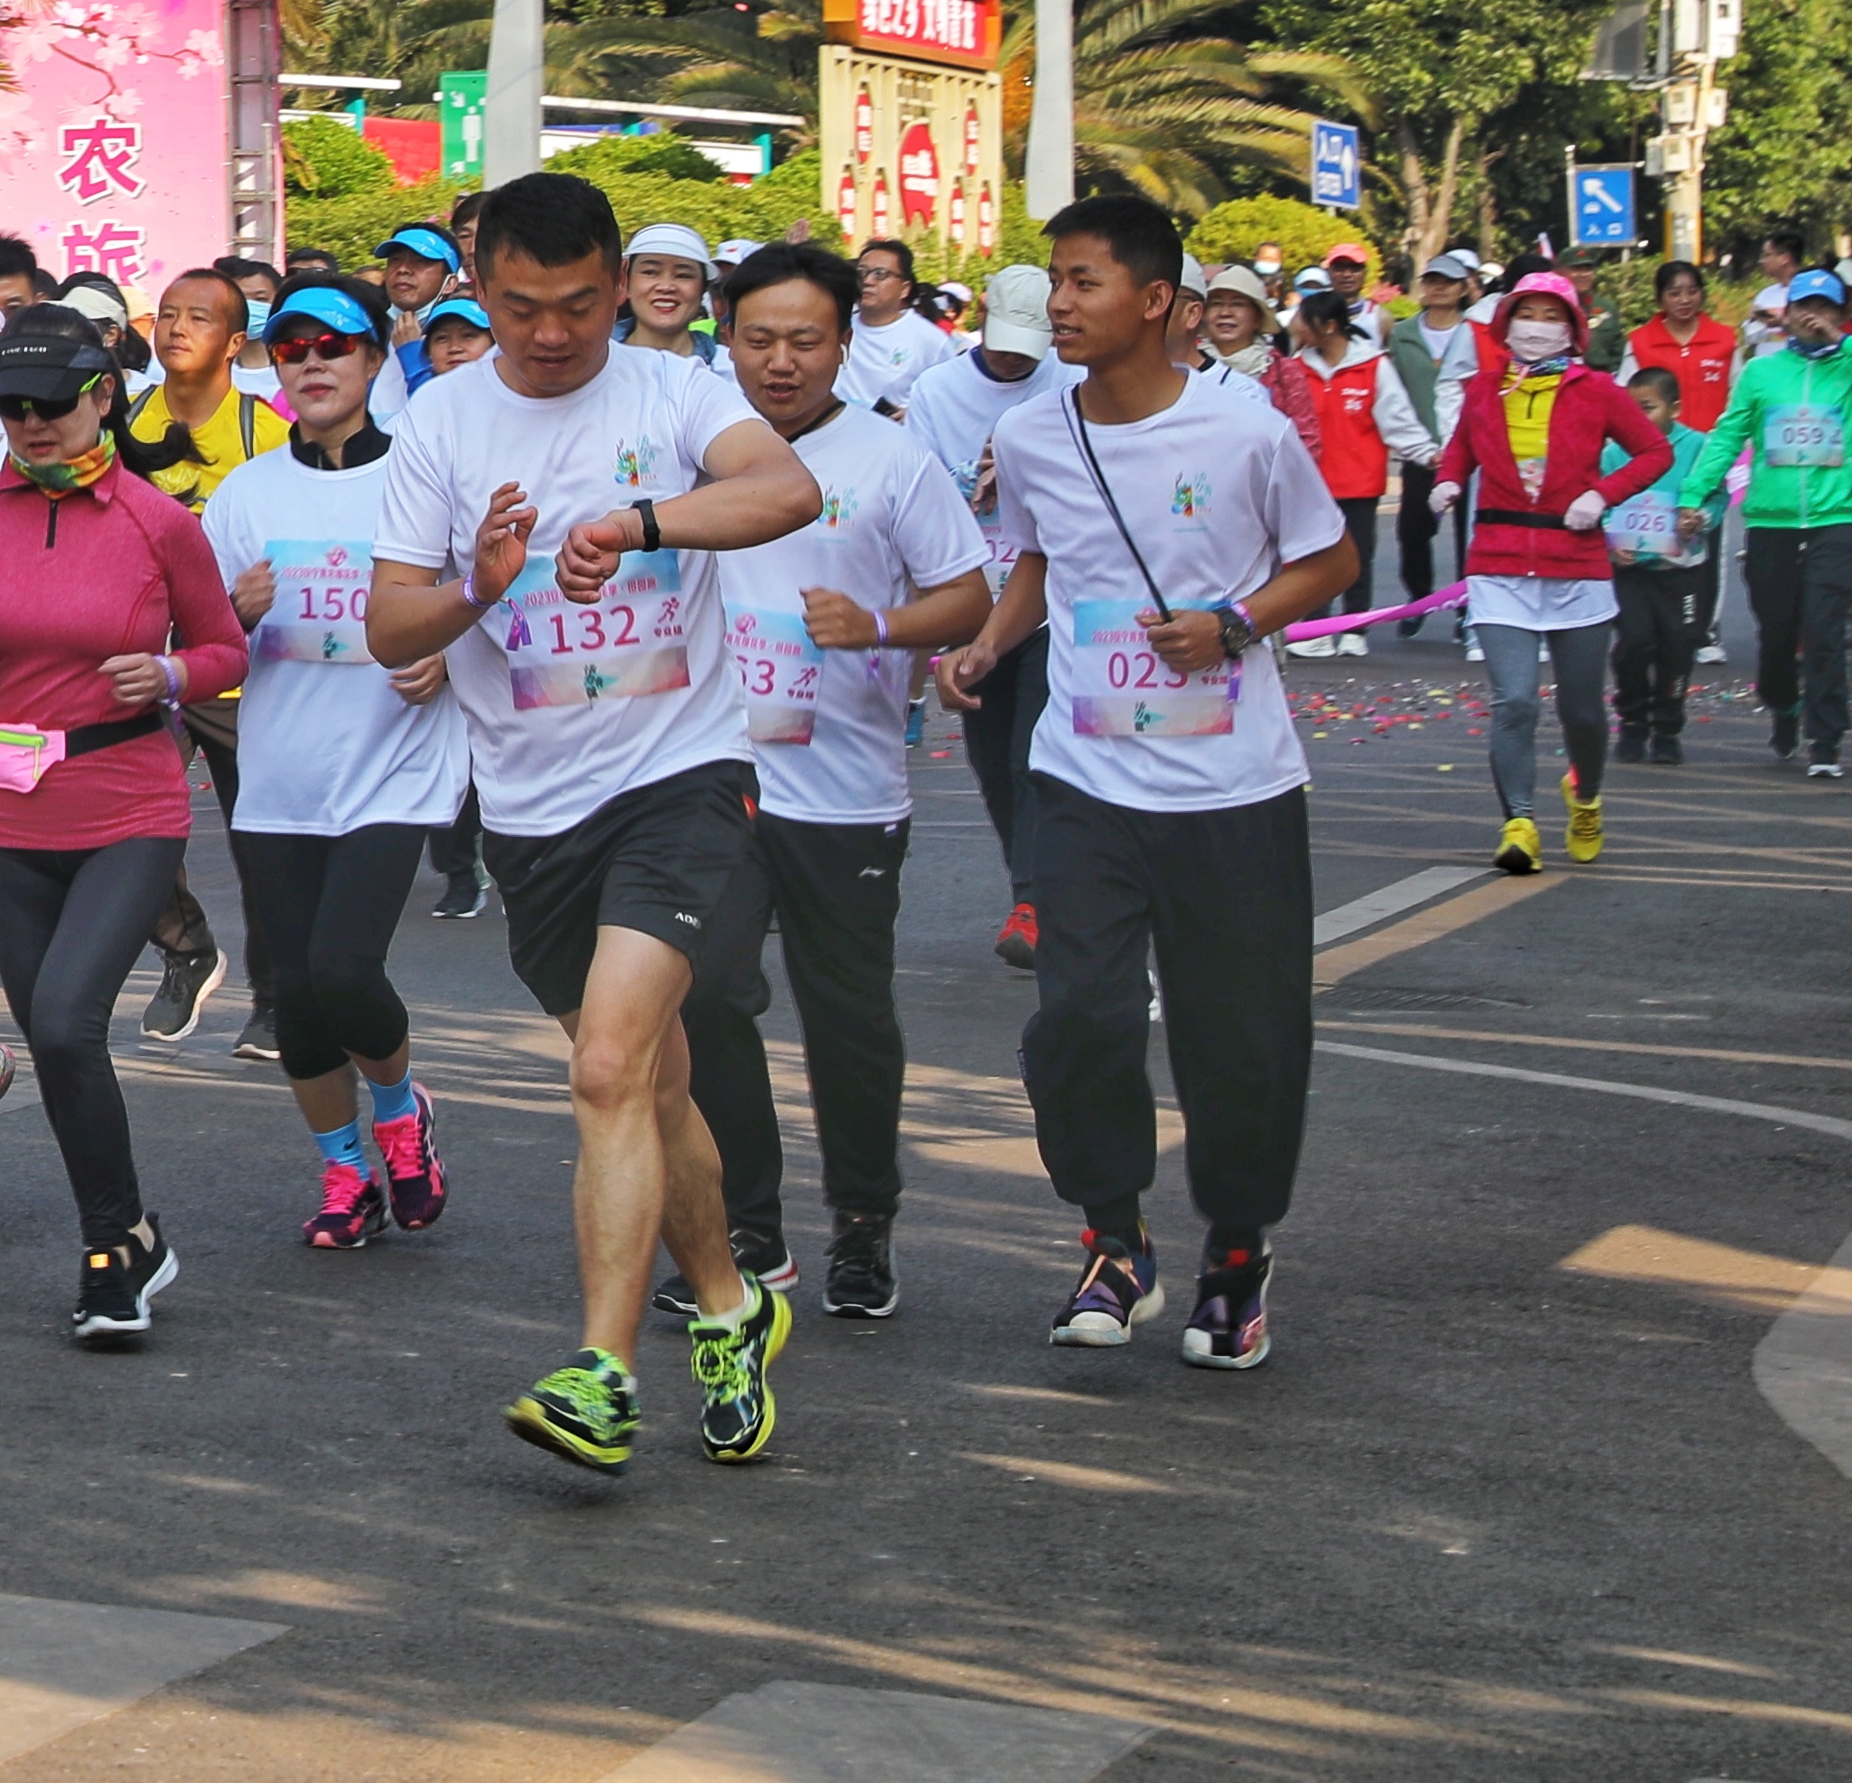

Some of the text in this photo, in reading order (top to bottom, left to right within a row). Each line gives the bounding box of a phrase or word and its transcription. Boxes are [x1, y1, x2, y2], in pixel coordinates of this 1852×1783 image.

[1782, 426, 1824, 445] 059
[1624, 512, 1666, 533] 026
[298, 586, 370, 623] 150
[549, 604, 641, 655] 132
